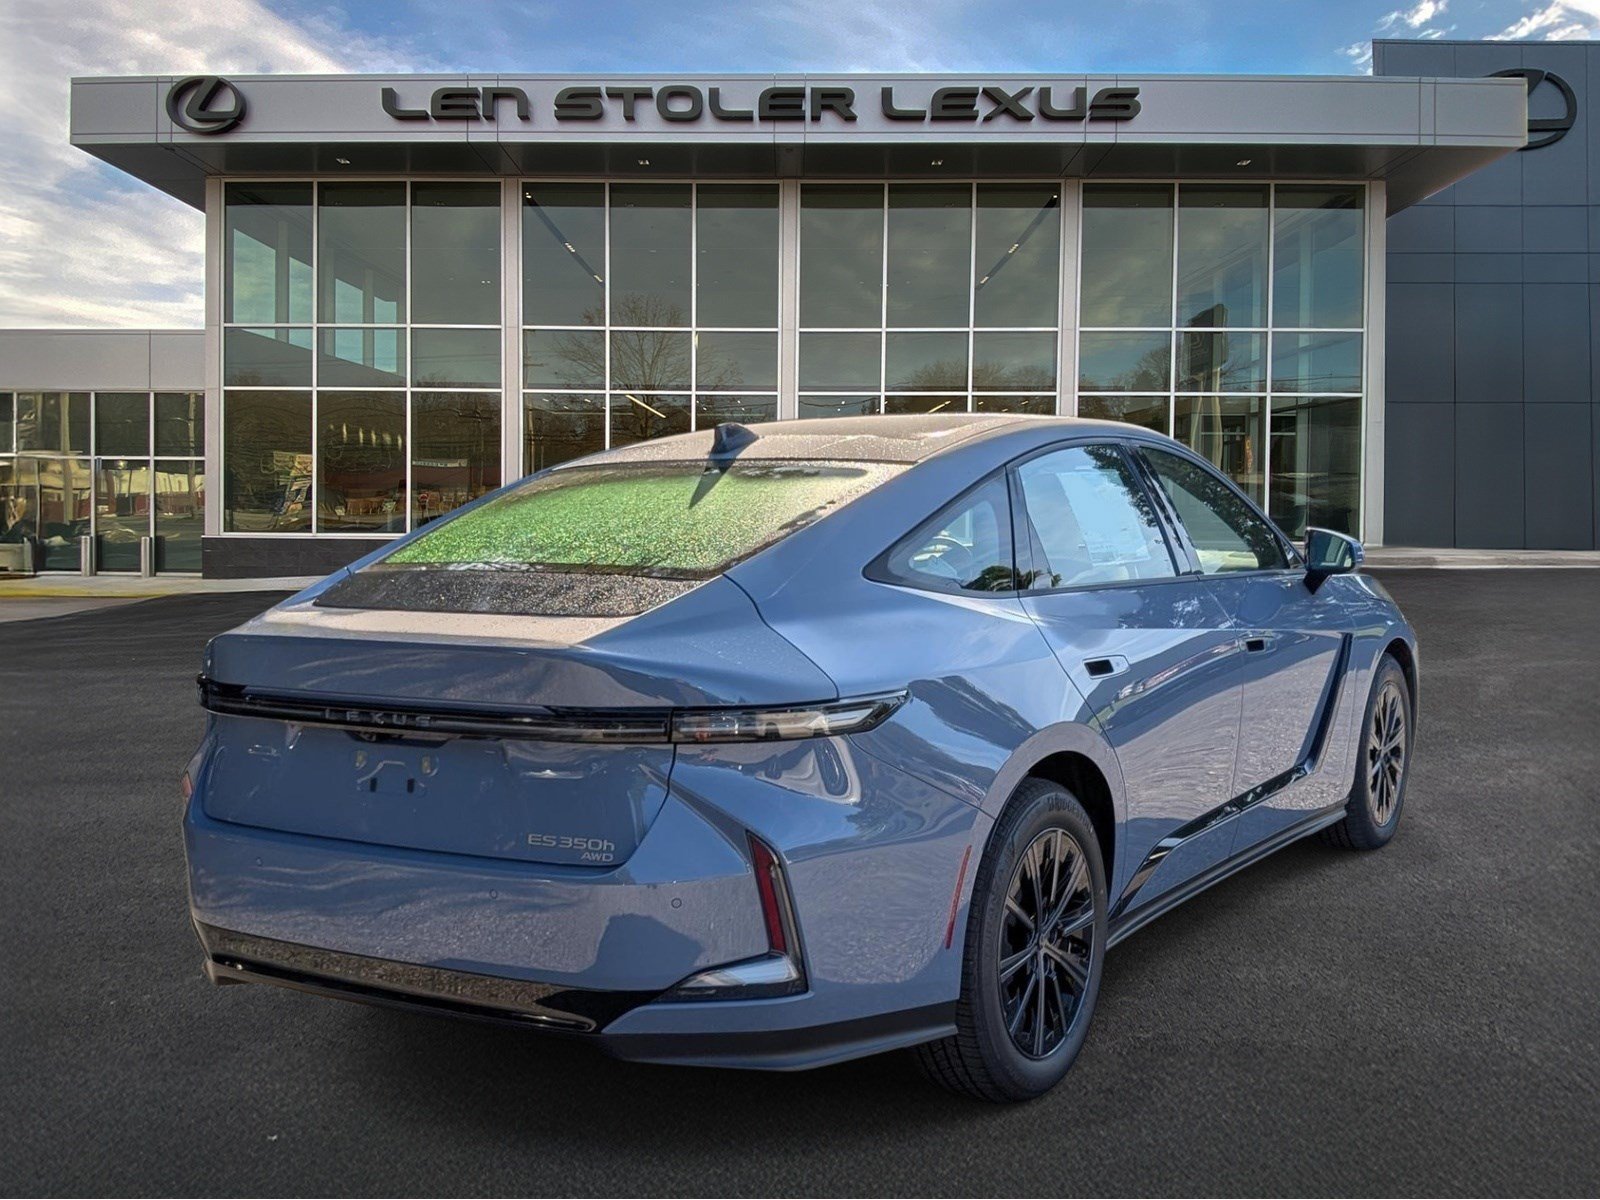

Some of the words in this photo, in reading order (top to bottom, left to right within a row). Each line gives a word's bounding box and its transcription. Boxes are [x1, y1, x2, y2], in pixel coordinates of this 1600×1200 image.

[381, 86, 530, 121] LEN
[554, 85, 857, 121] STOLER
[881, 86, 1142, 121] LEXUS
[325, 708, 431, 727] LEXUS
[581, 851, 614, 862] AWD
